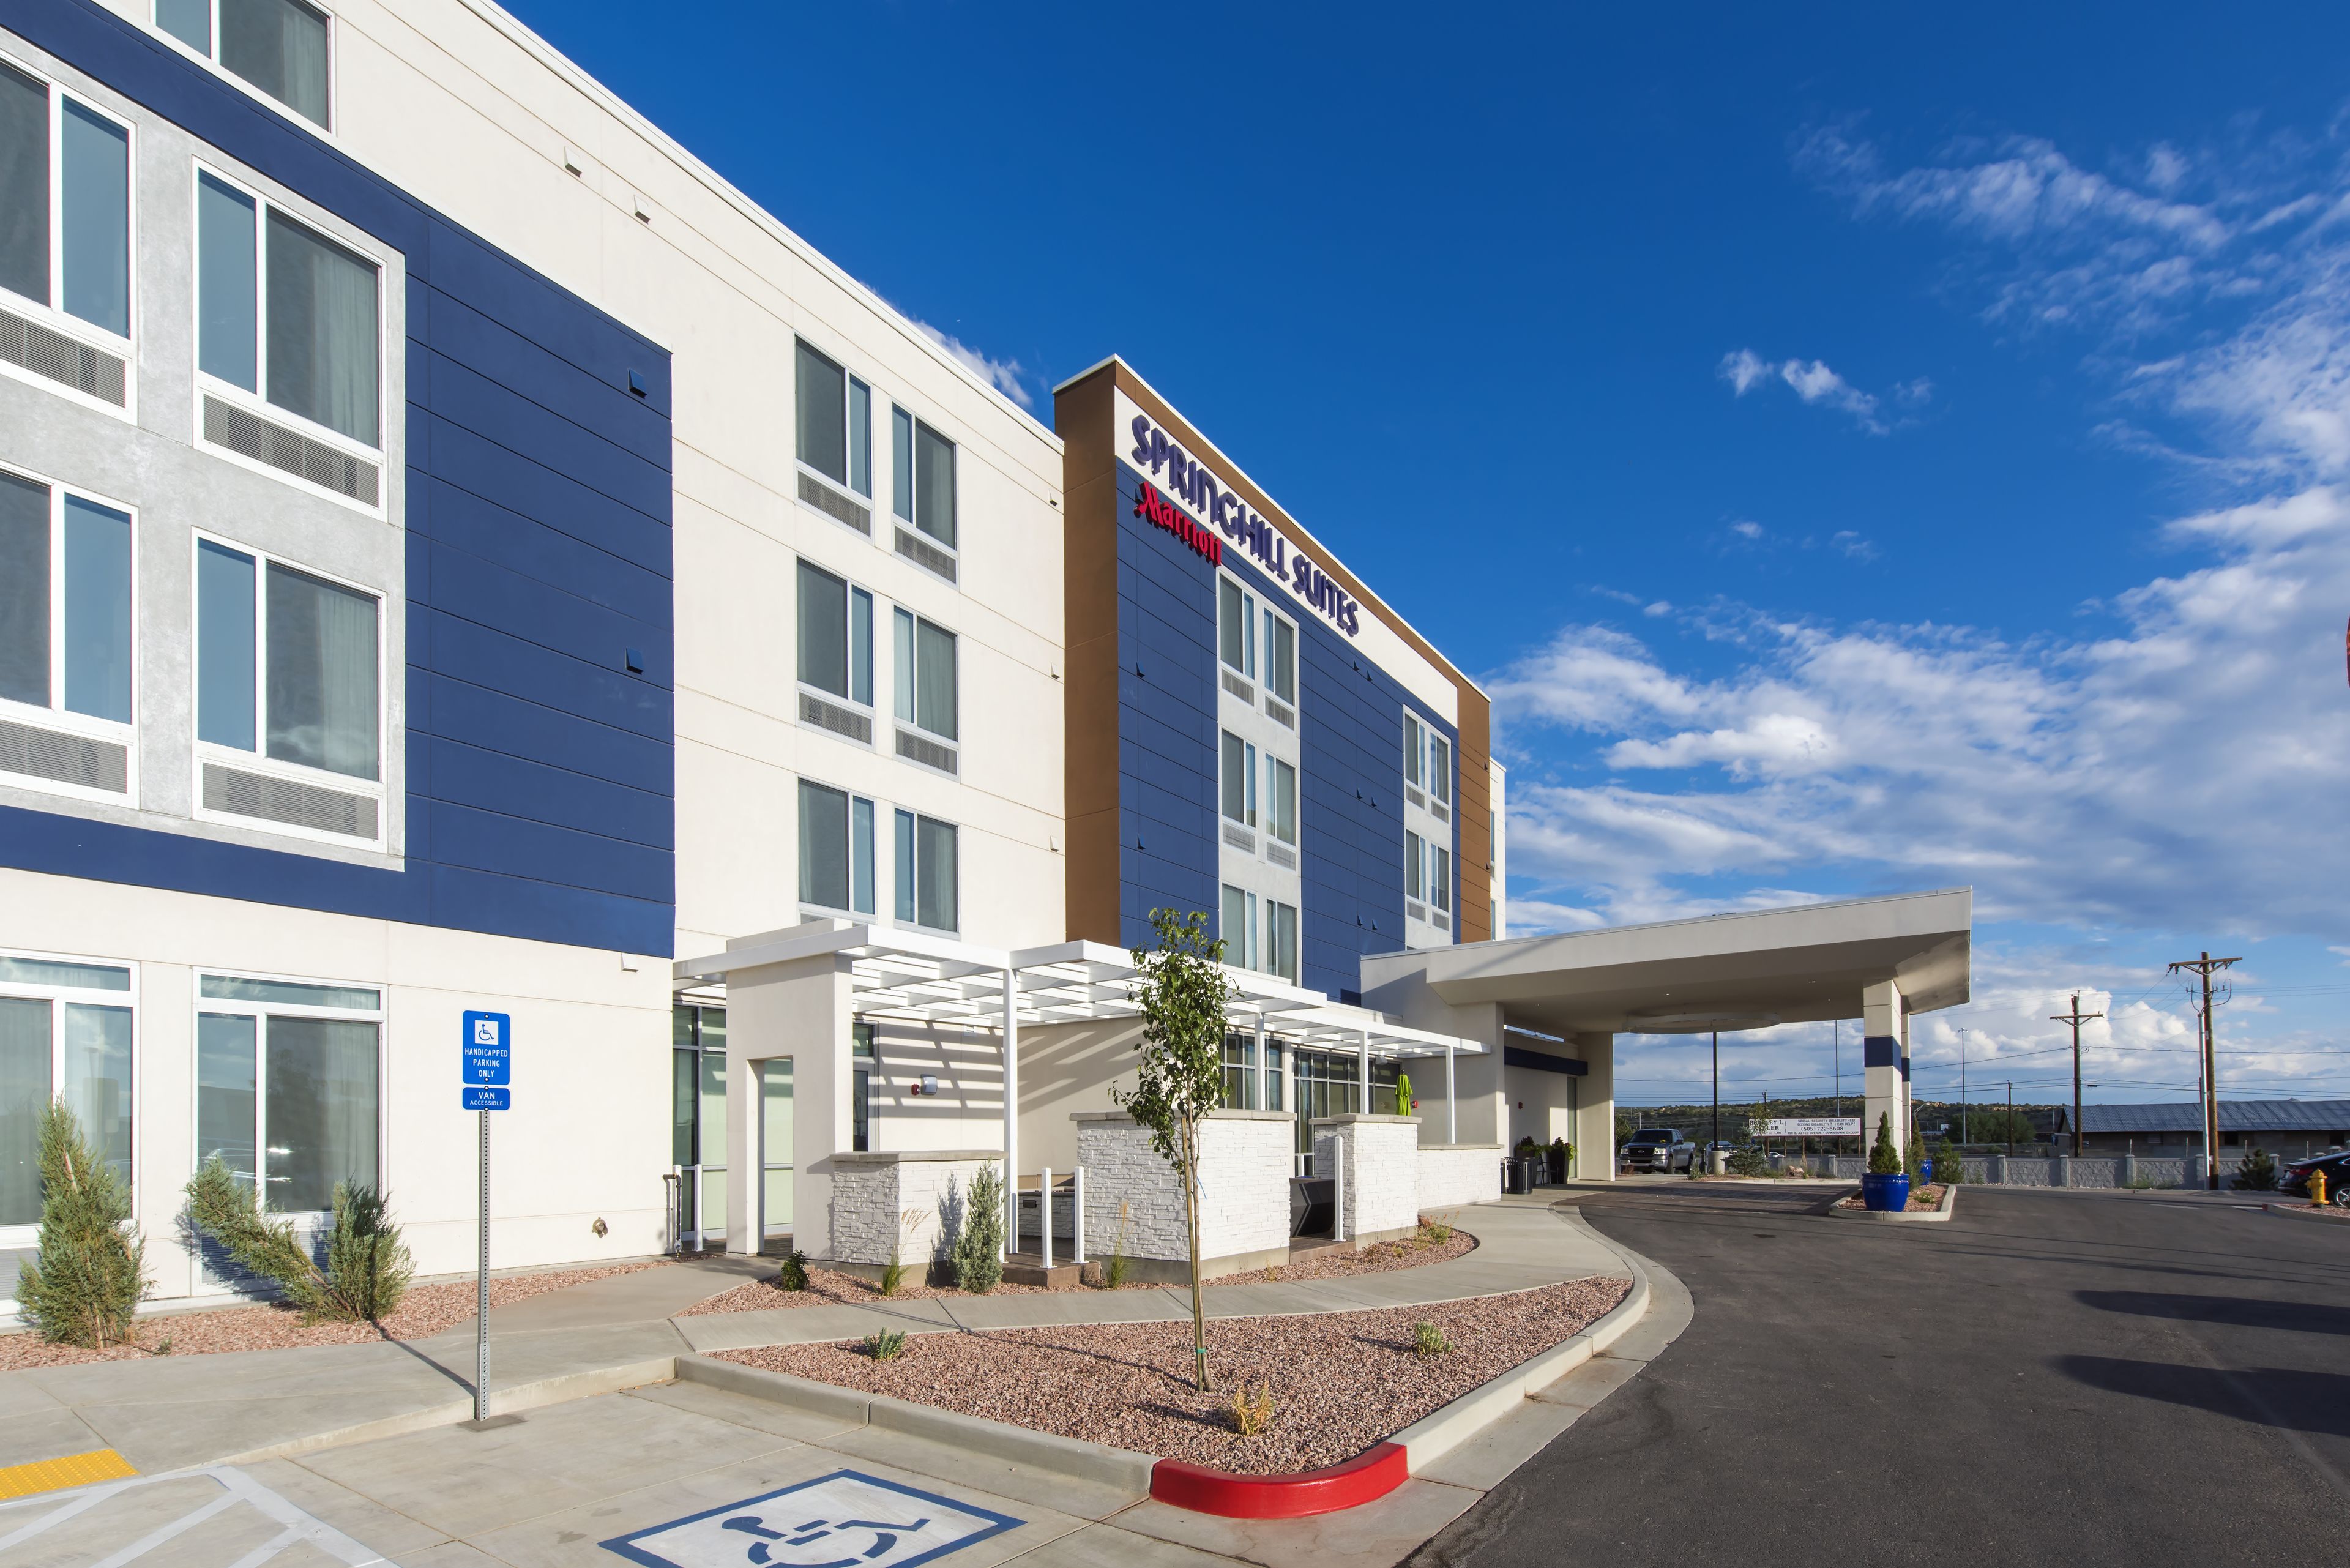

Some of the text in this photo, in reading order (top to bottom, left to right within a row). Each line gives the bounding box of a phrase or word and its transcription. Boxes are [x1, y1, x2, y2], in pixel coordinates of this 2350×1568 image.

[1132, 414, 1359, 638] SPRINGHILL SUITES
[1133, 481, 1222, 569] Marriott
[464, 1047, 508, 1057] HANDICAPPED
